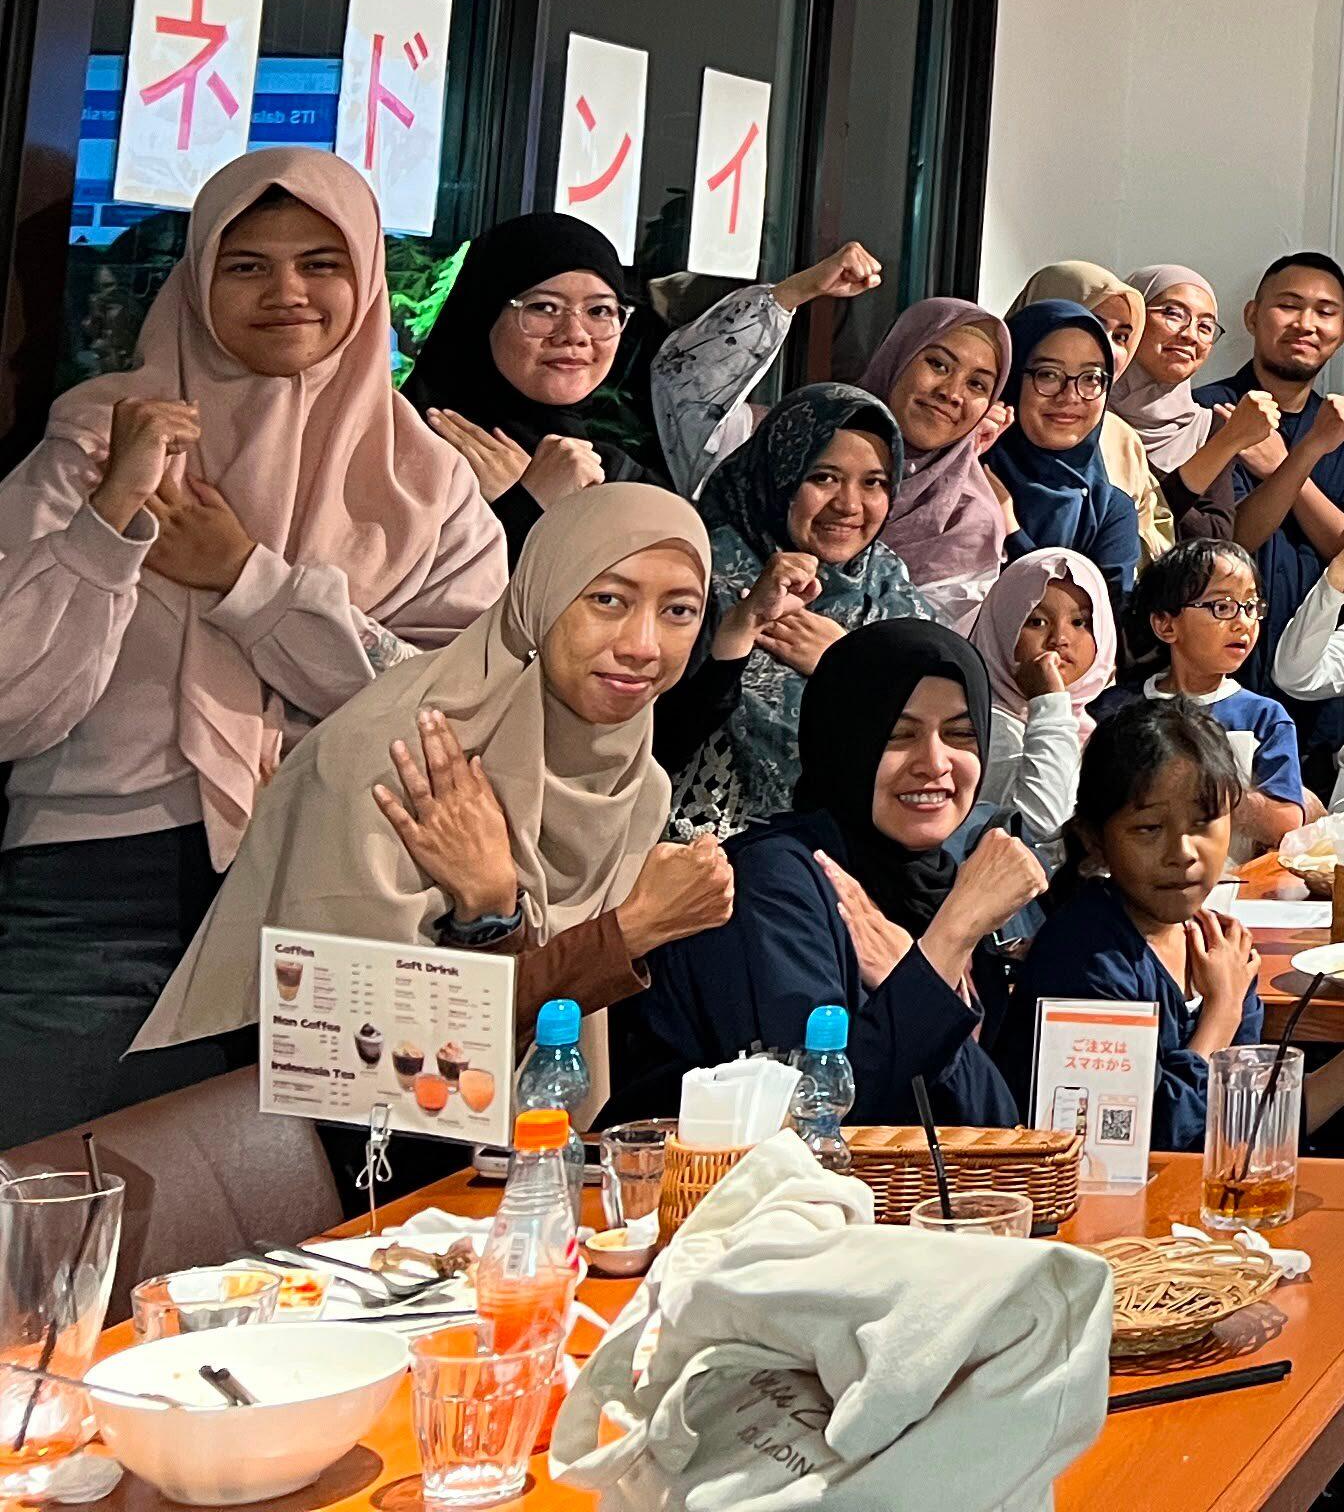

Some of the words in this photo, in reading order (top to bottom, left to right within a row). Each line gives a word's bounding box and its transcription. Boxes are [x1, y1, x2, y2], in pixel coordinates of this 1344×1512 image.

[363, 32, 429, 171] ド
[568, 95, 632, 205] ン
[707, 122, 759, 235] イ
[396, 959, 423, 972] Soft
[425, 963, 459, 977] Drink
[273, 1015, 298, 1028] Non
[300, 1018, 341, 1033] Coffee
[1071, 1038, 1129, 1055] ご注文は
[1064, 1055, 1132, 1072] スマホから
